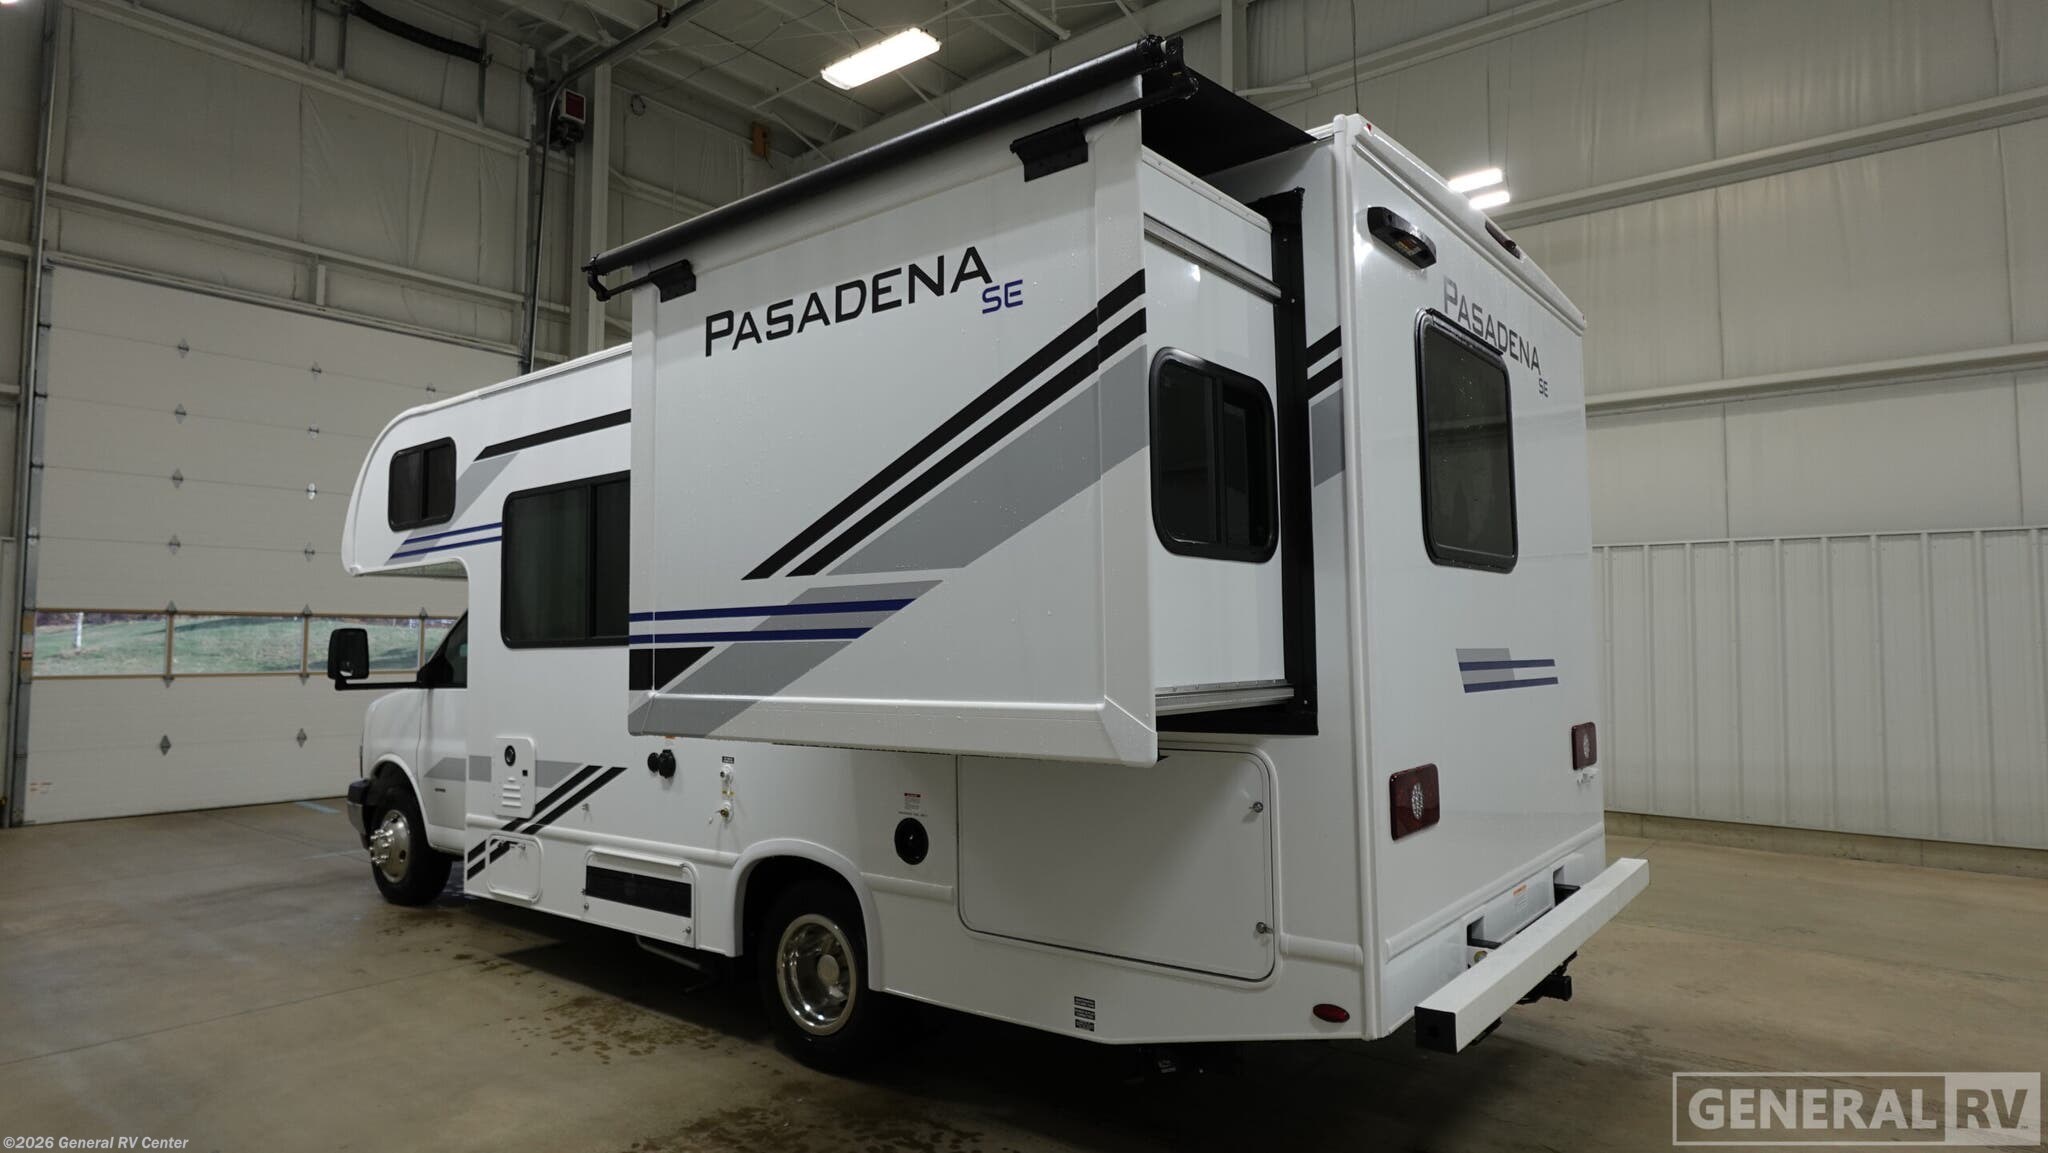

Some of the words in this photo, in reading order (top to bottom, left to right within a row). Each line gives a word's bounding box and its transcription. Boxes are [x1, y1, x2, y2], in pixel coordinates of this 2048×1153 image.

[705, 246, 993, 356] PASADENA
[982, 279, 1023, 314] SE
[1444, 277, 1542, 374] PASADENA
[1538, 379, 1549, 399] SE
